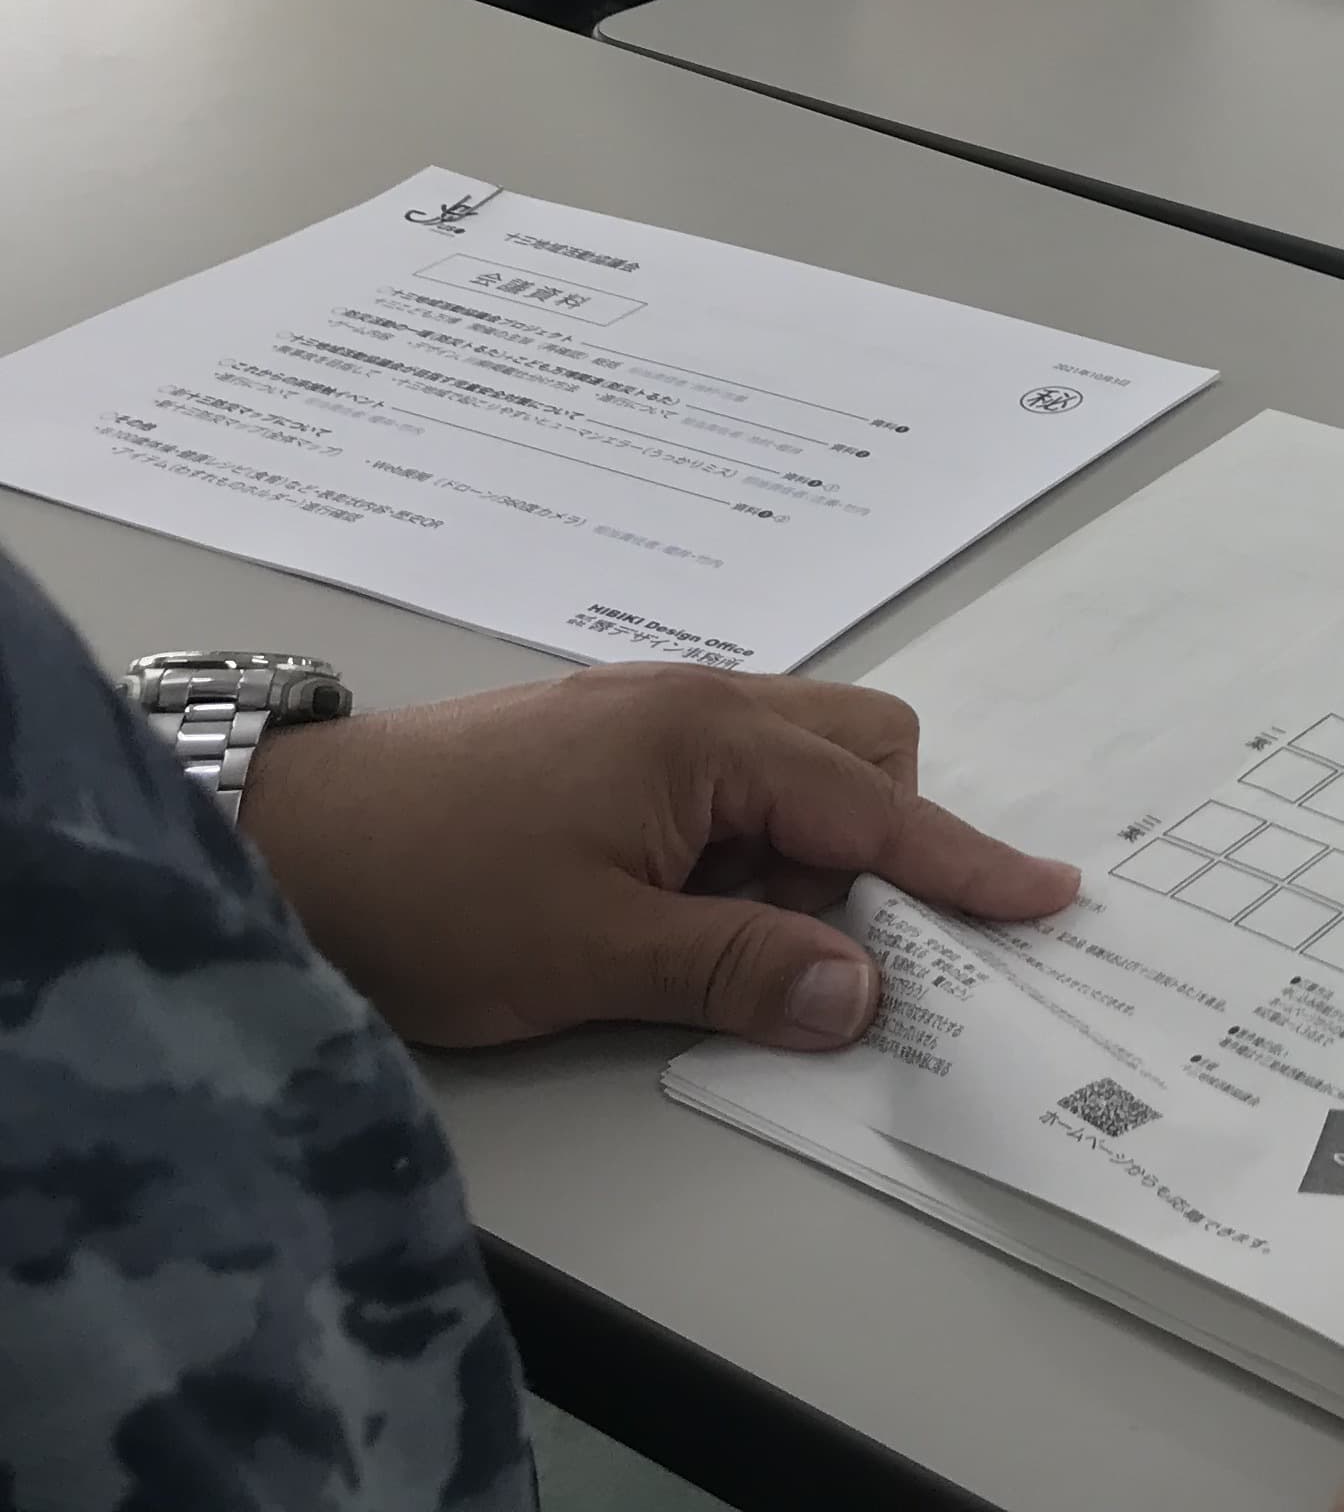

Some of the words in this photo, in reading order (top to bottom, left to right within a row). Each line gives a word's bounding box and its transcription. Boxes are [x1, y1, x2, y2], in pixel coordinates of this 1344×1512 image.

[505, 232, 641, 274] 十三地域活動協議会
[469, 272, 592, 310] 会議資料
[587, 603, 645, 629] HIBIKI
[646, 618, 703, 646] Design
[703, 635, 756, 658] Office
[1245, 725, 1287, 752] 二案
[1116, 813, 1163, 843] 三案
[1038, 1109, 1271, 1255] ホームページからも応募できます。
